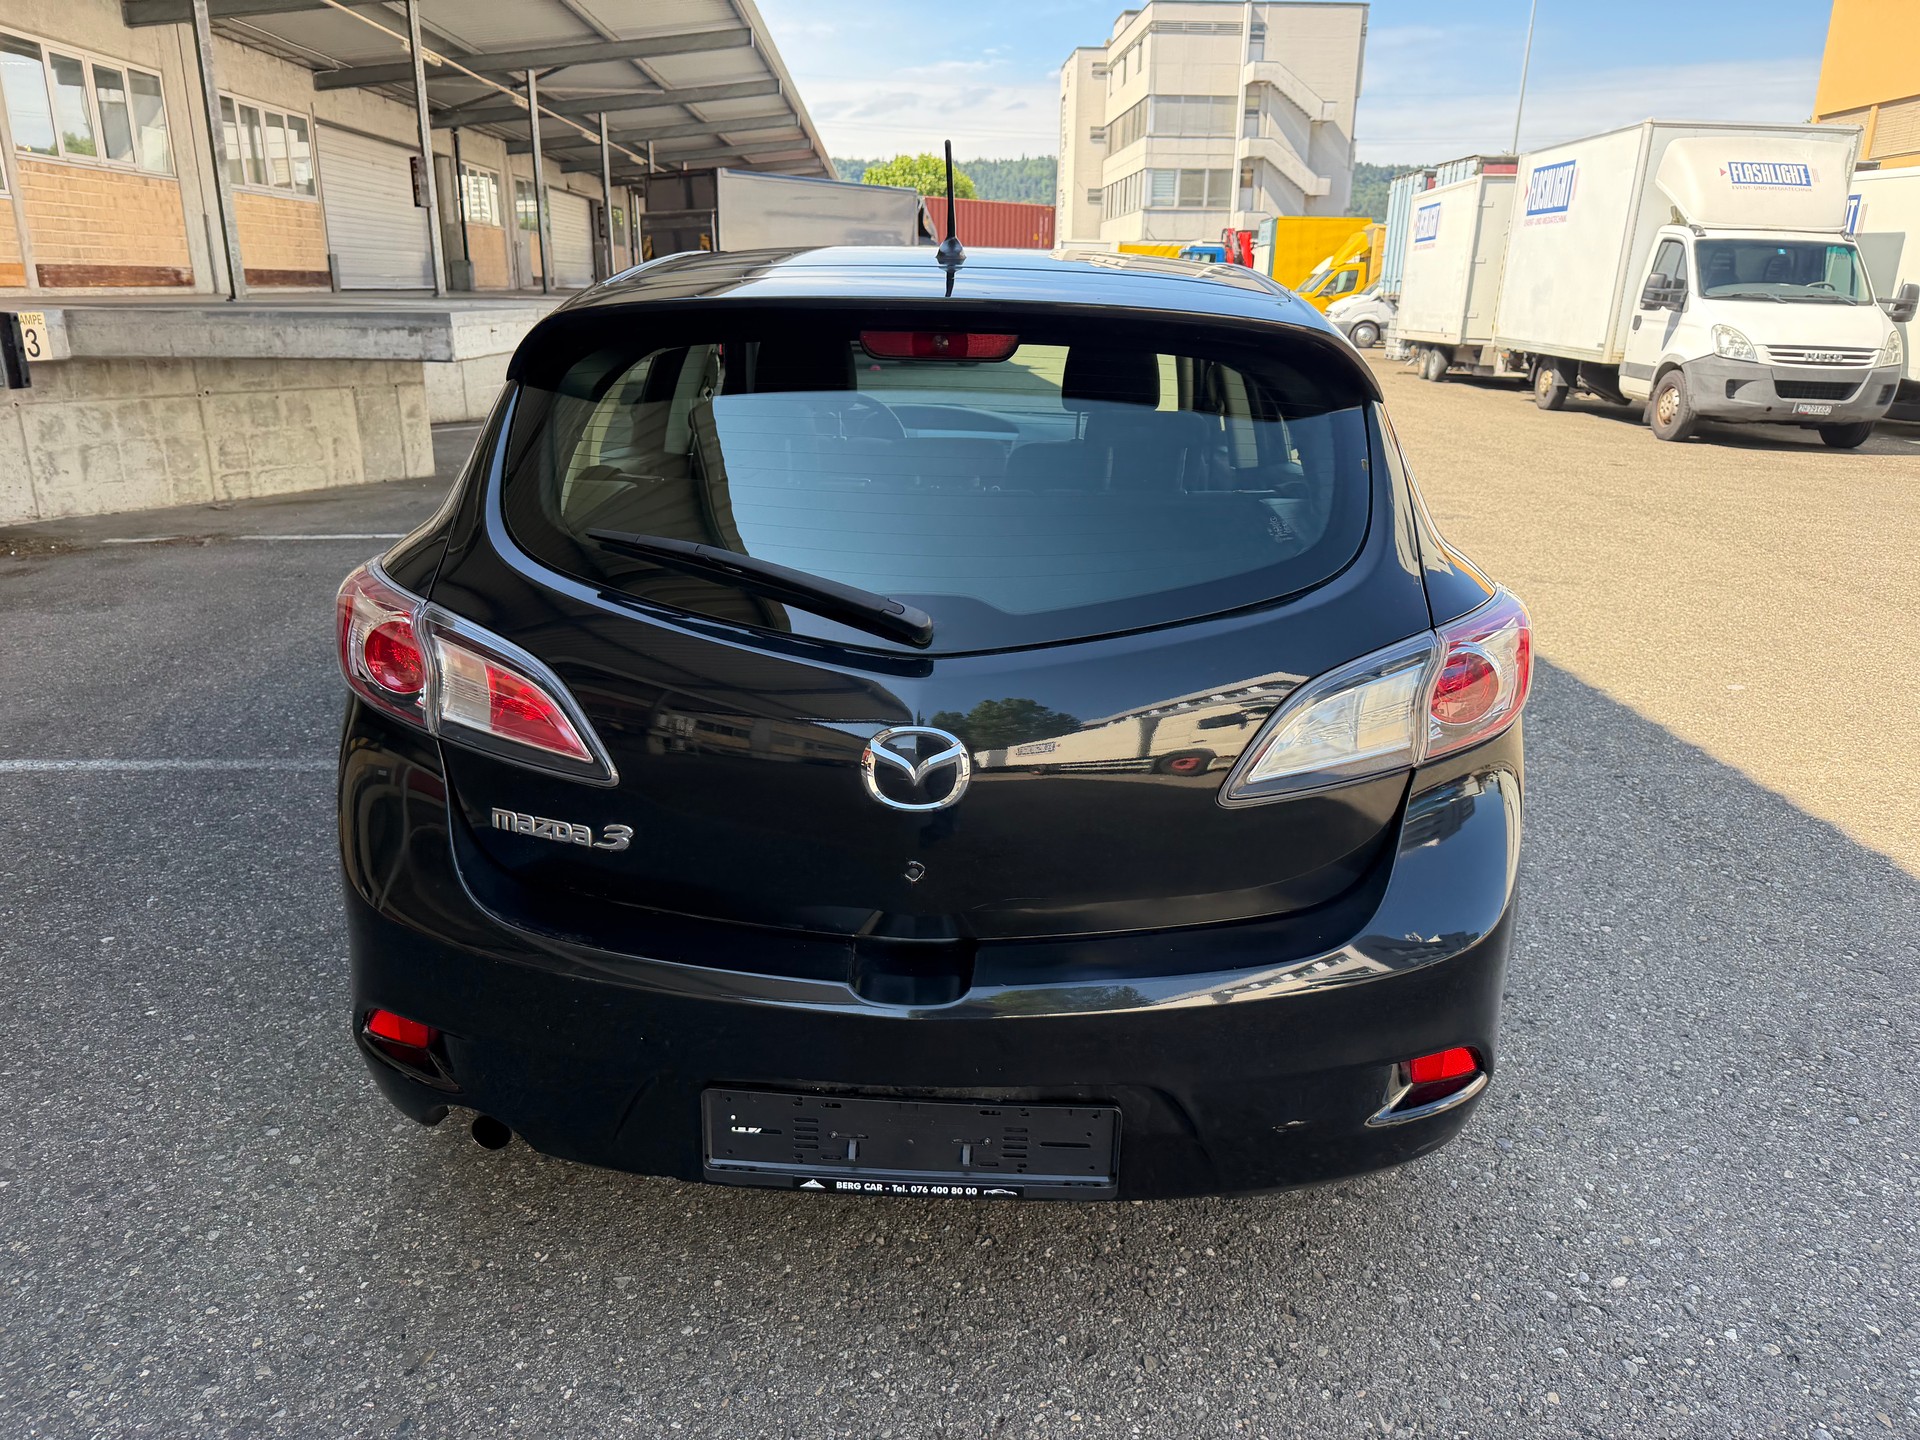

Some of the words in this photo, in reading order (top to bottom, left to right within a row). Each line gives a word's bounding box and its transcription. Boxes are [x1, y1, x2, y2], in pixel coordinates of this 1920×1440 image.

[1730, 163, 1808, 185] FLASHLIGHT
[1527, 164, 1575, 211] FLASHLIGHT
[19, 314, 43, 325] AMPE
[25, 328, 41, 357] 3
[592, 824, 634, 851] 3
[836, 1181, 861, 1190] BERG
[863, 1183, 883, 1191] CAR
[891, 1184, 909, 1193] Tel.
[910, 1185, 928, 1194] 076
[930, 1186, 949, 1195] 400
[950, 1187, 963, 1195] 80
[965, 1187, 978, 1196] 00
